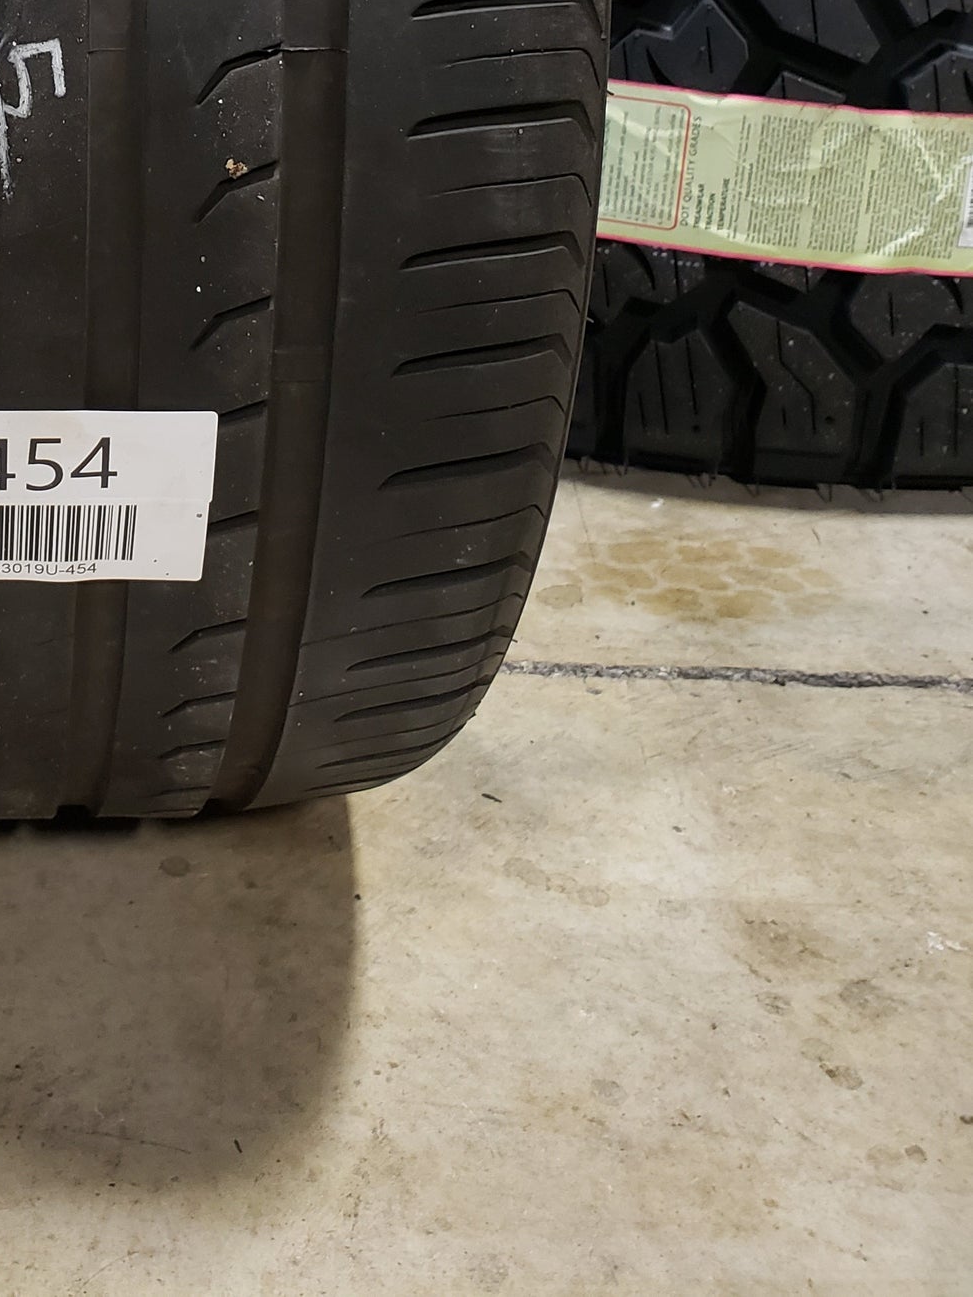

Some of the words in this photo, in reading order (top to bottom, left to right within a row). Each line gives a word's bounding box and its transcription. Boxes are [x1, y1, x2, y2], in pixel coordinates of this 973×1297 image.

[689, 116, 702, 156] GRADES
[683, 161, 695, 203] QUALITY
[681, 207, 690, 227] DOT
